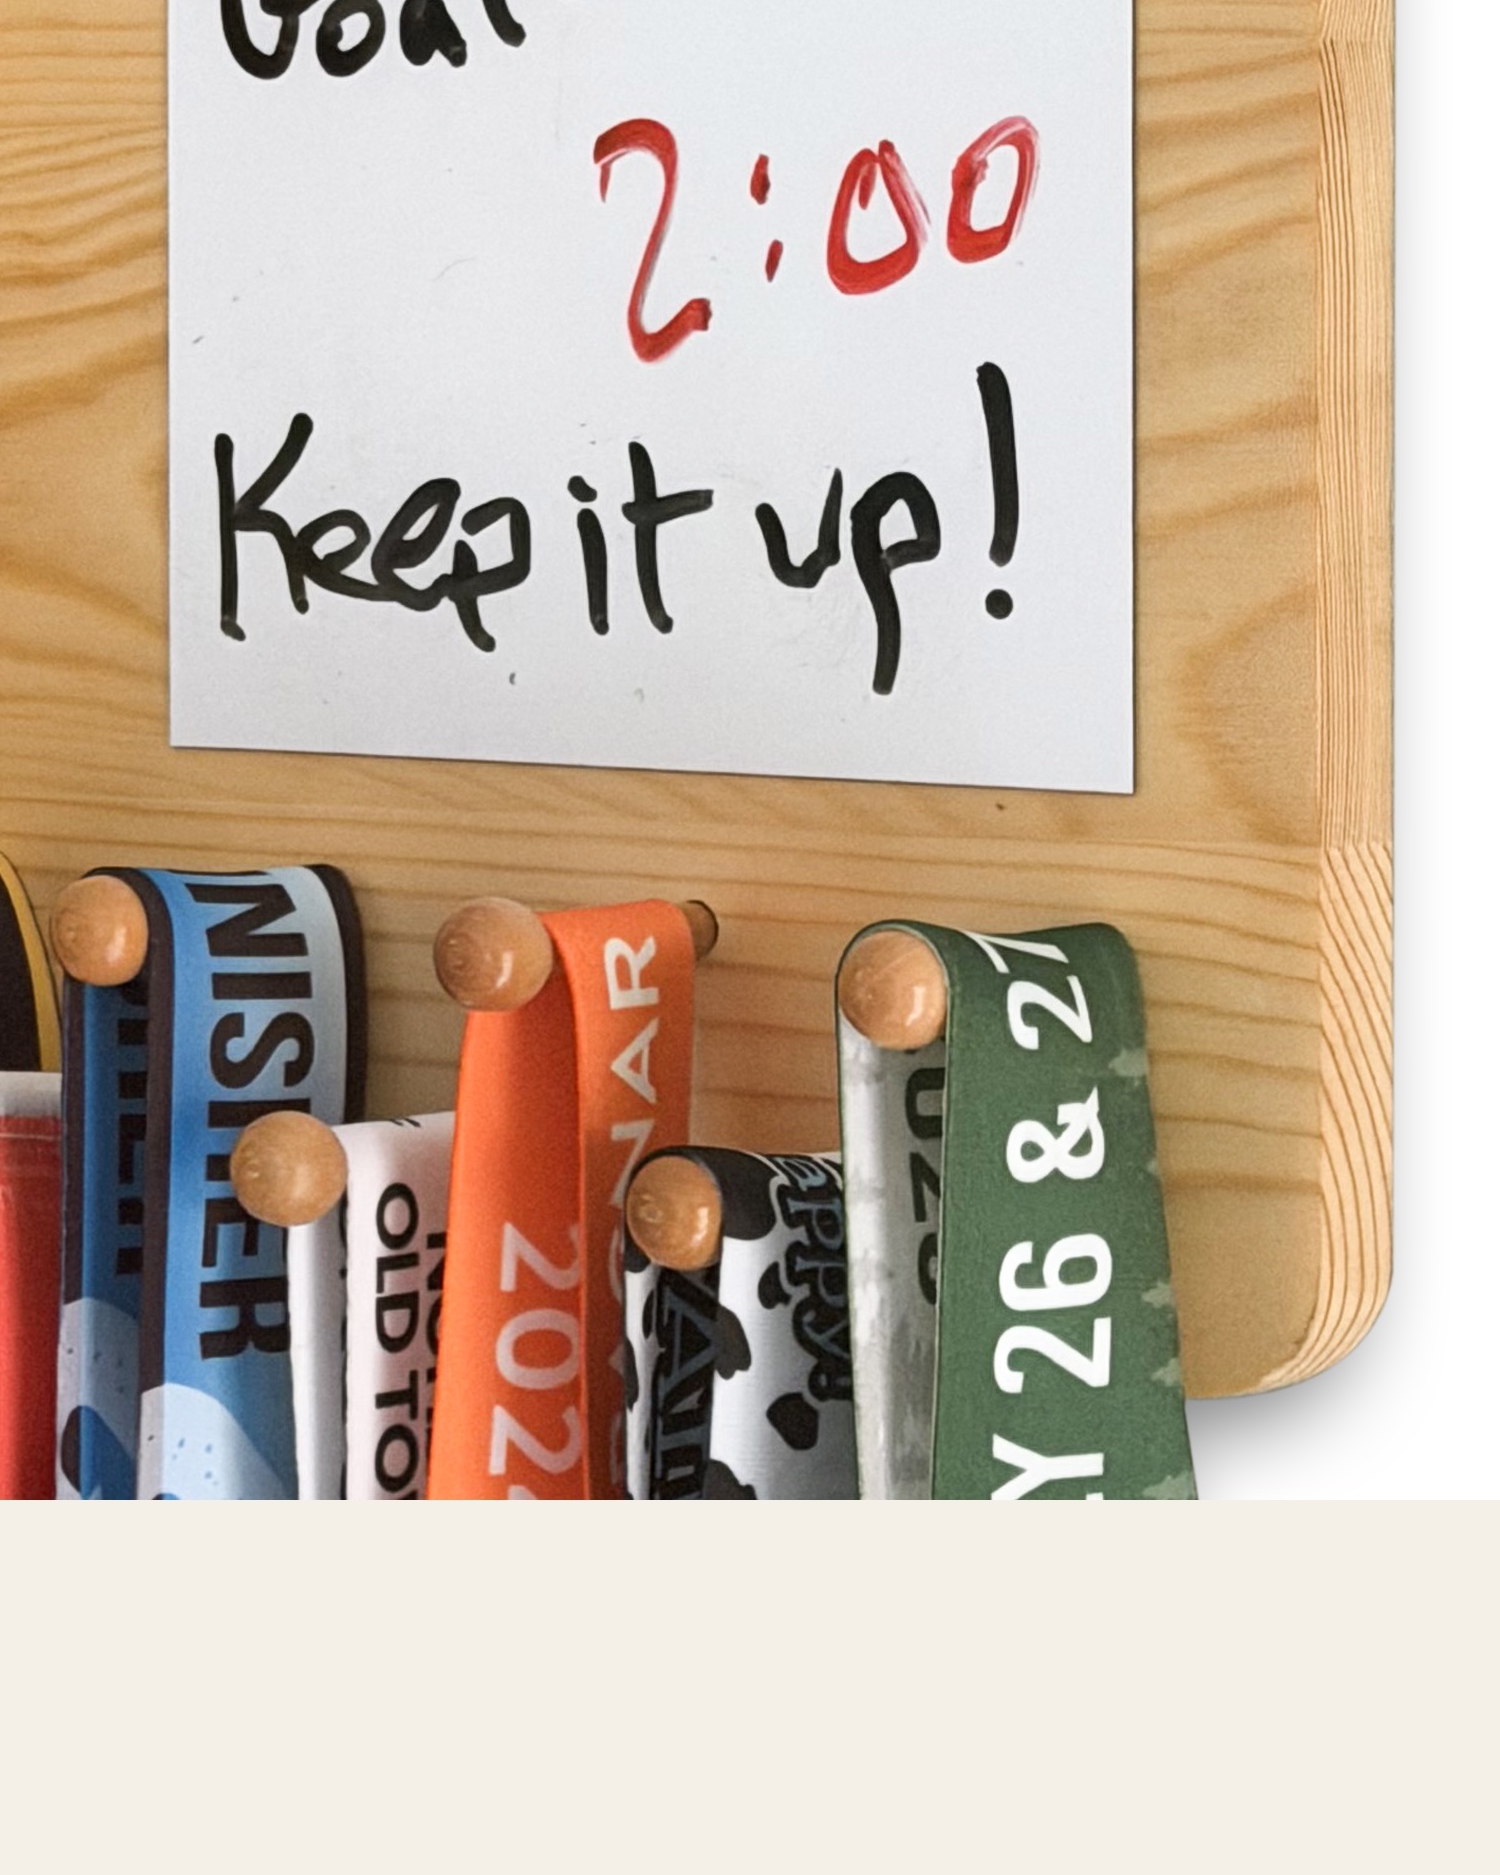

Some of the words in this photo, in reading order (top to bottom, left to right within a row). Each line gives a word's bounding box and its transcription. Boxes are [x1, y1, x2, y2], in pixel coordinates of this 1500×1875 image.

[593, 116, 1040, 363] 2:00
[214, 412, 532, 653] Keep
[568, 441, 714, 636] it
[962, 928, 1093, 1050] 27
[1006, 1086, 1106, 1183] &
[375, 1182, 420, 1354] OLD
[993, 1232, 1113, 1393] 26
[374, 1370, 420, 1499] TO
